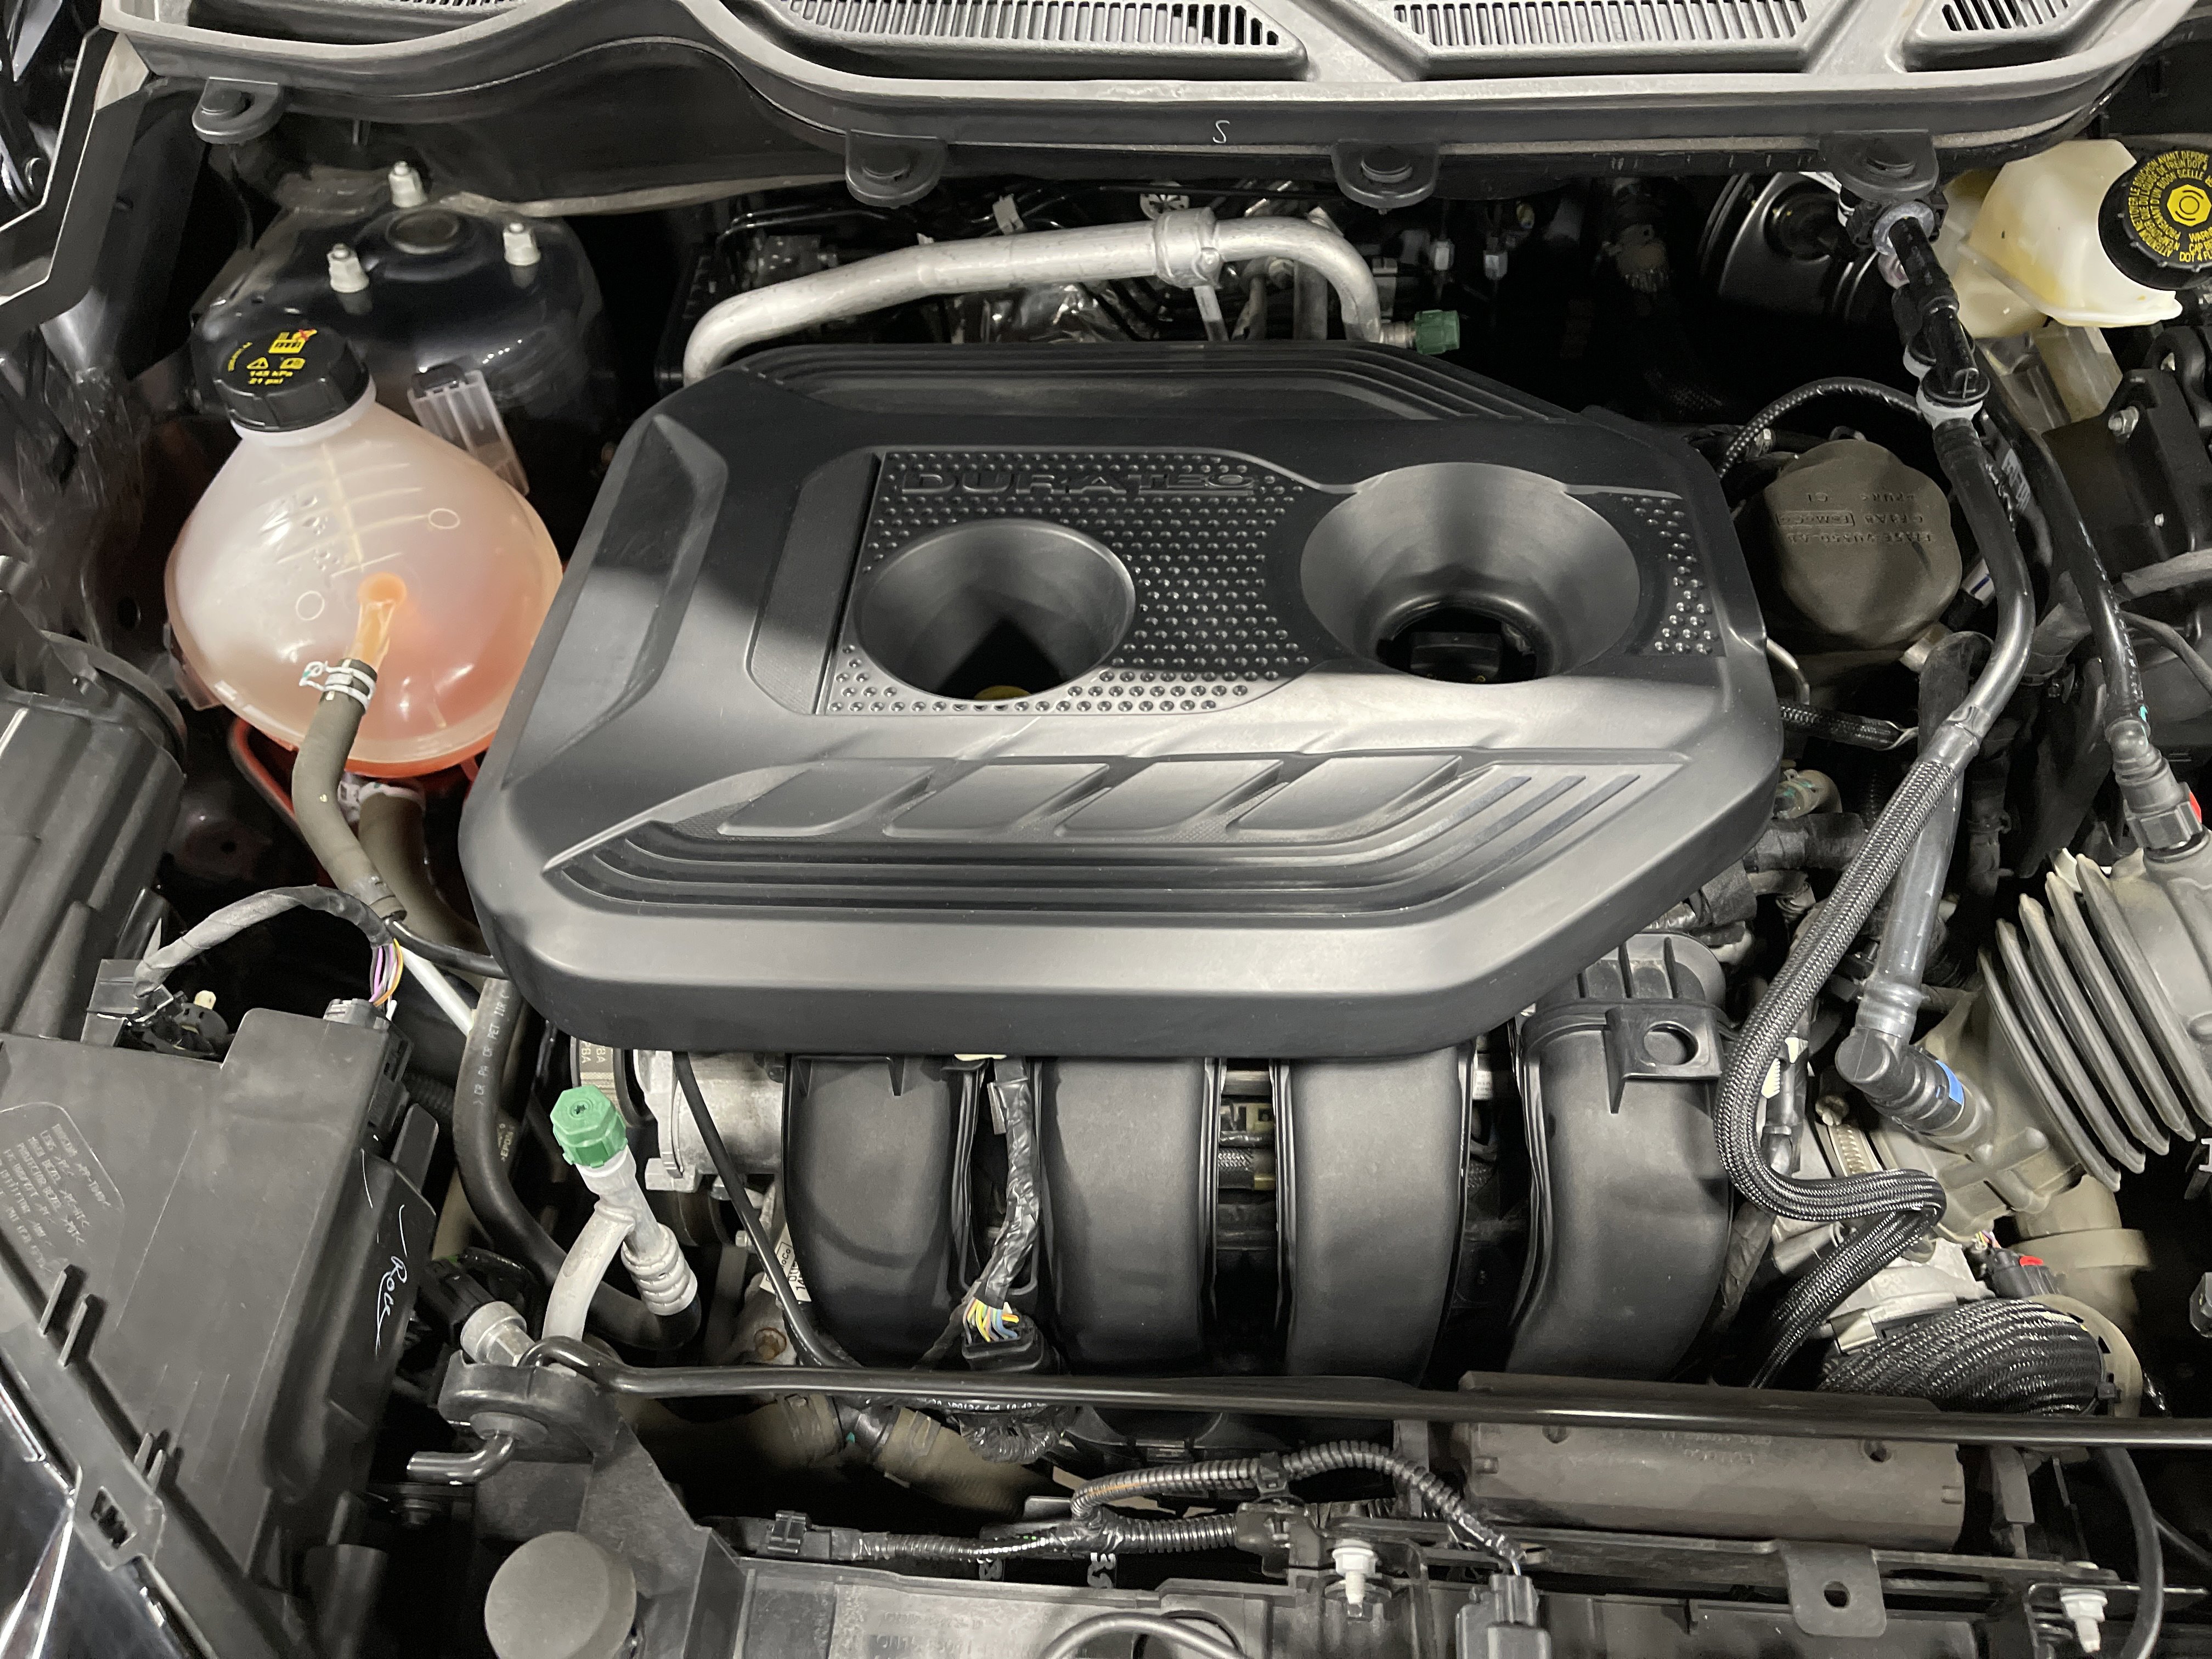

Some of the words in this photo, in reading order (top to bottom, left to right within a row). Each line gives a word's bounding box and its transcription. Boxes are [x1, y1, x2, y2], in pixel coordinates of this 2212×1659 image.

[1212, 120, 1230, 144] S
[2132, 159, 2158, 188] BOUCHON
[2158, 151, 2181, 165] AVANT
[2179, 251, 2194, 262] DOT
[2197, 250, 2203, 262] 4
[487, 1023, 500, 1040] PET
[596, 1047, 606, 1063] 8A
